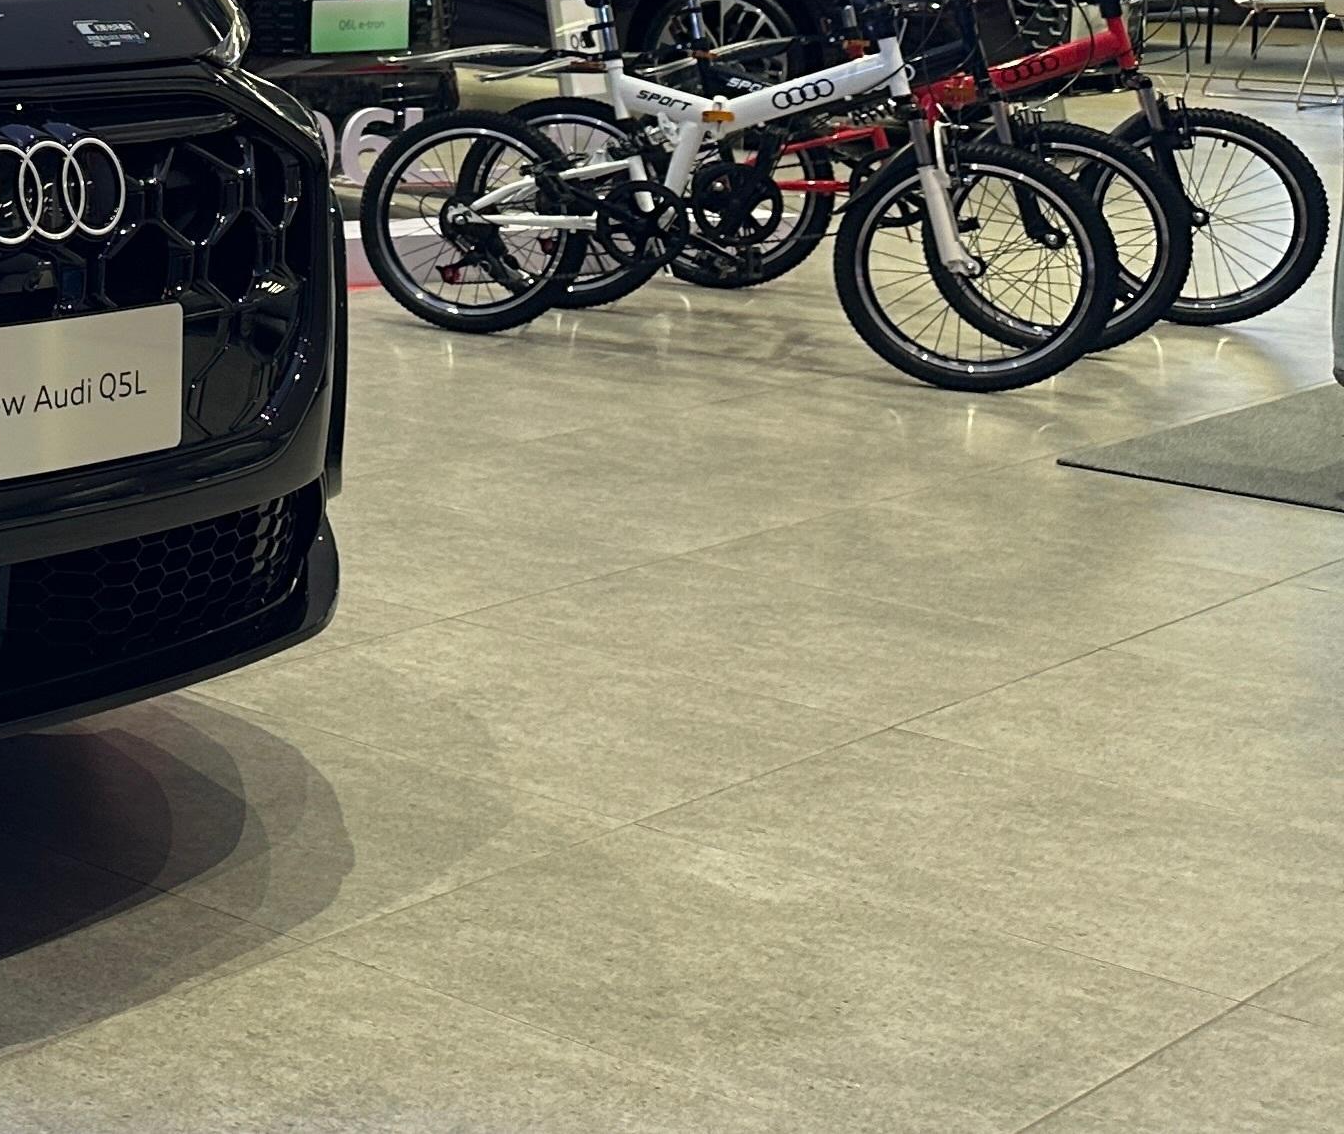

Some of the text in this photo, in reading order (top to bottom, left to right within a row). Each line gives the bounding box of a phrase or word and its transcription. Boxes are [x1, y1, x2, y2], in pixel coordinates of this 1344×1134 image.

[338, 19, 385, 30] Q6L e-tron
[636, 89, 692, 111] SPORT
[33, 376, 92, 413] Audi
[98, 368, 147, 400] Q5L
